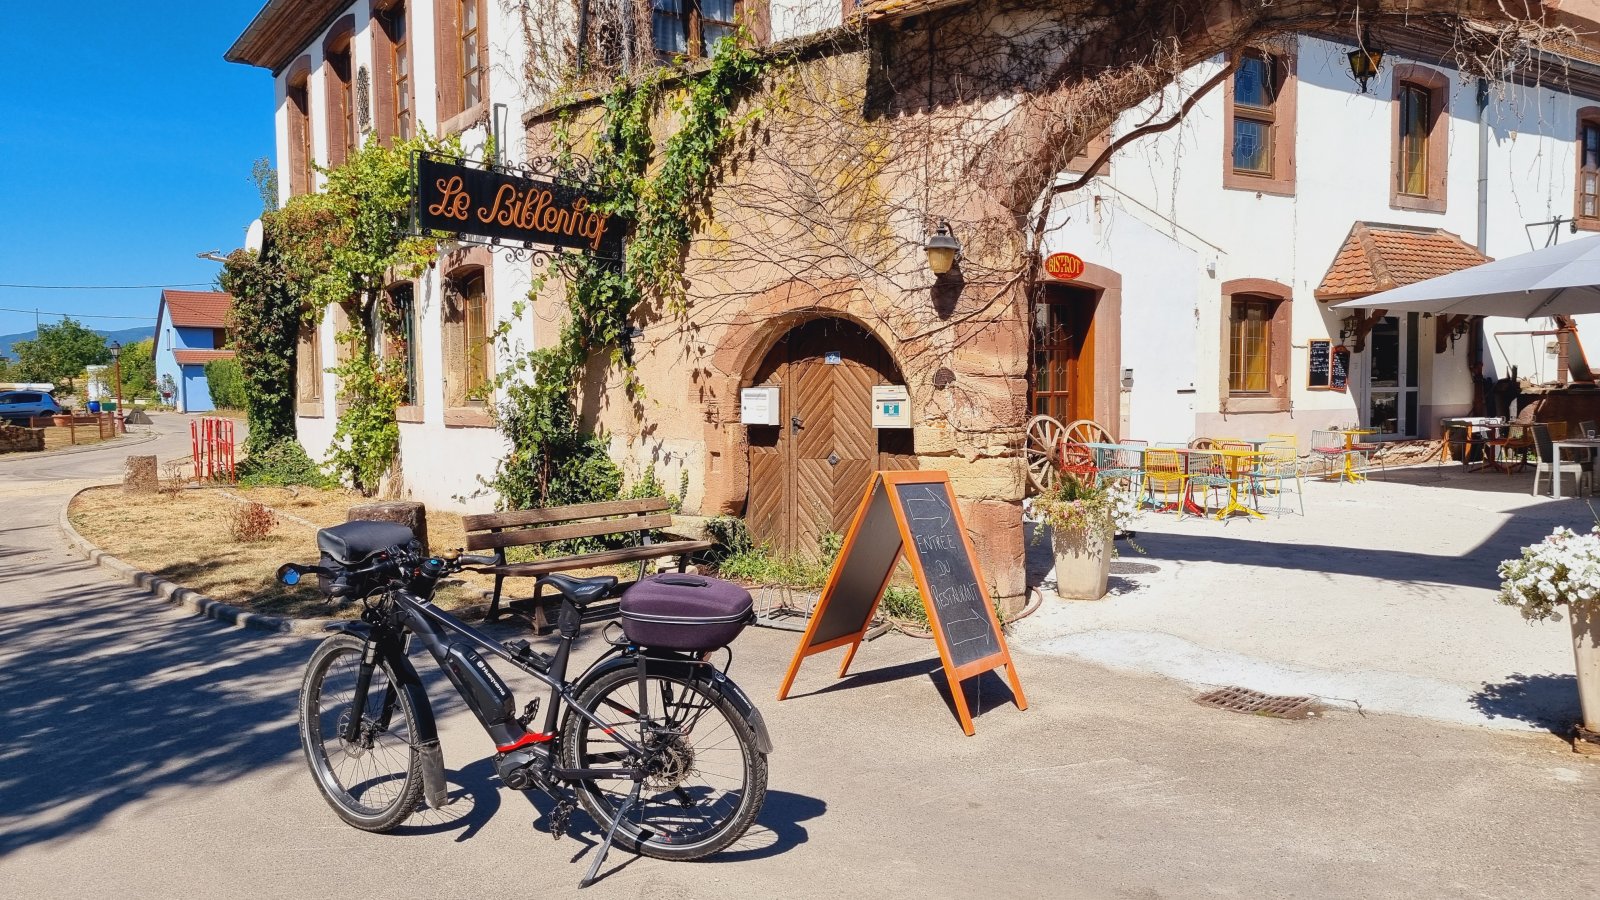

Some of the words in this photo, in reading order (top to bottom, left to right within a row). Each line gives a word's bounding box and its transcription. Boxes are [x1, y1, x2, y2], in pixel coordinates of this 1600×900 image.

[428, 175, 471, 221] Le
[1048, 255, 1081, 274] BISTROT
[935, 559, 951, 576] DU
[481, 666, 506, 696] Husqvarna
